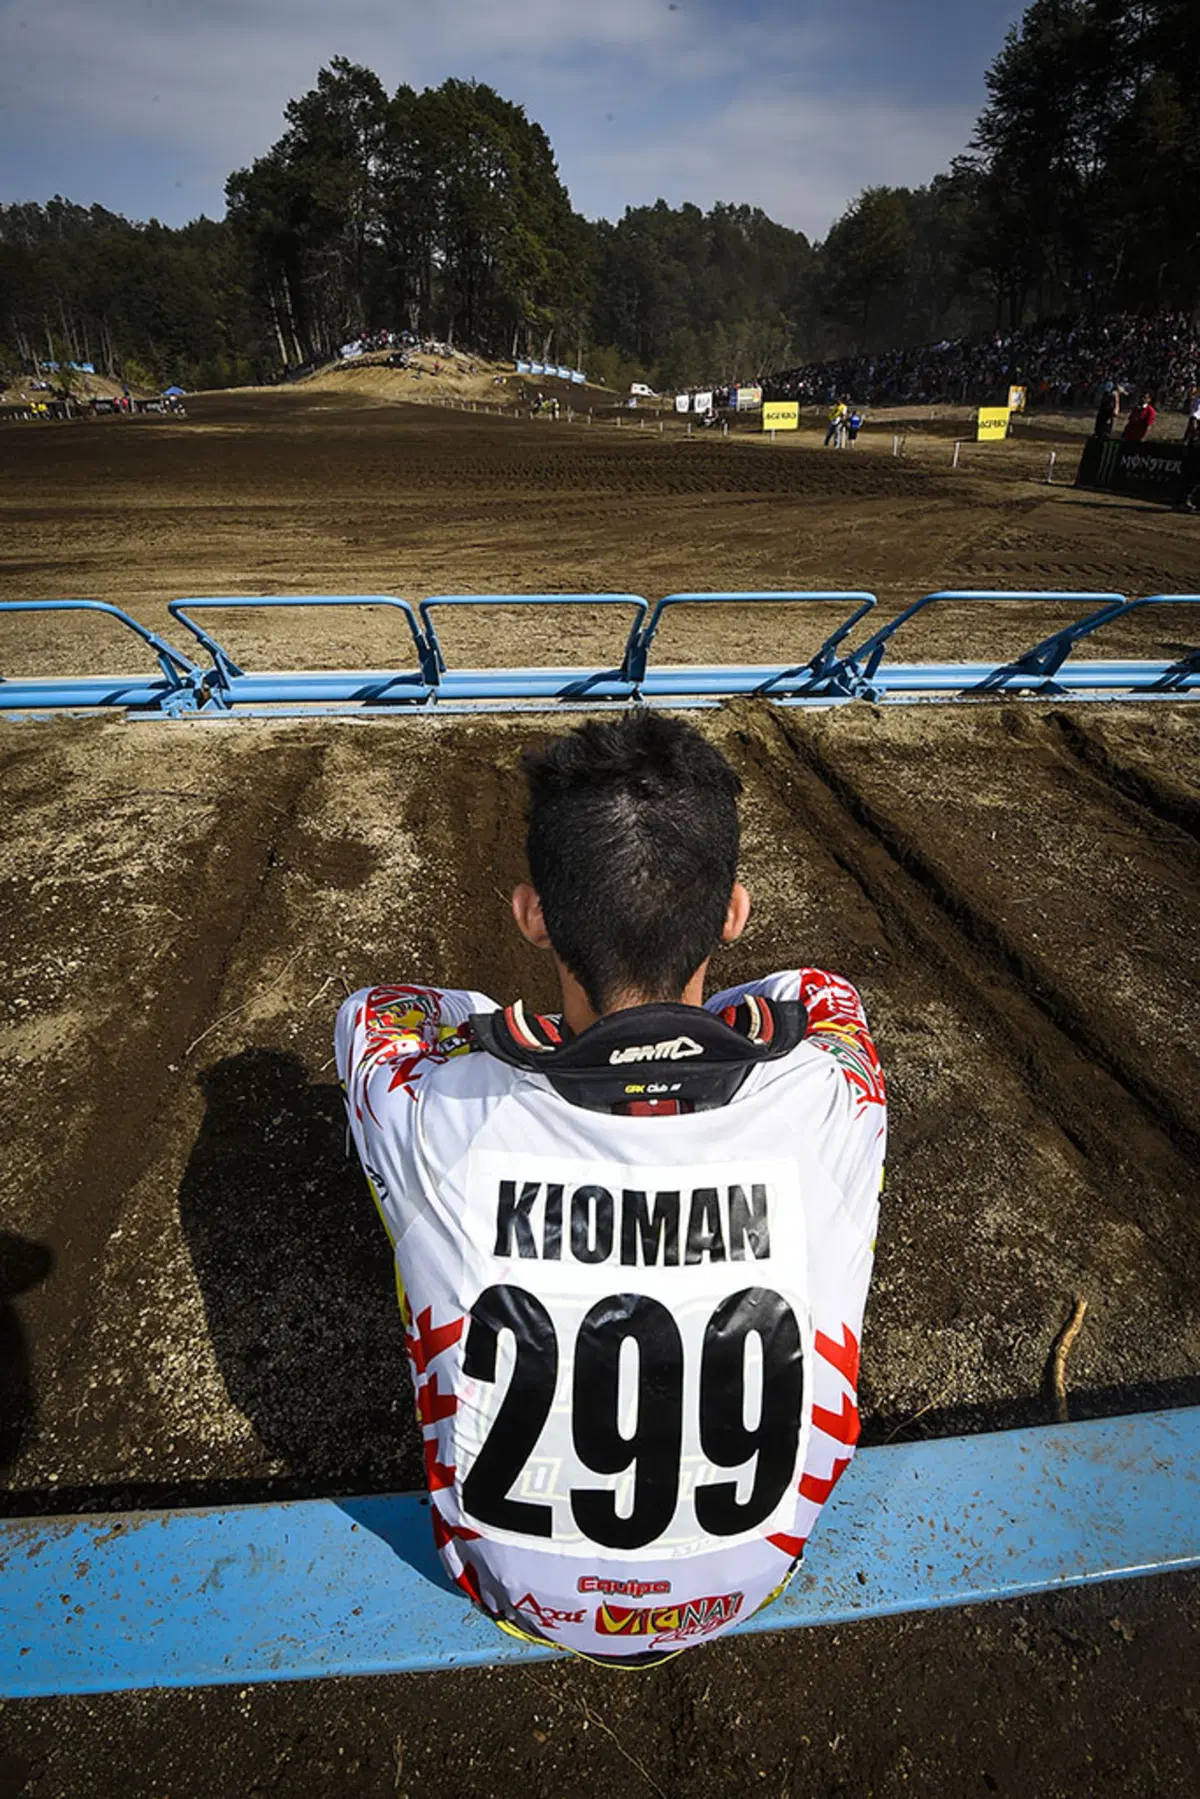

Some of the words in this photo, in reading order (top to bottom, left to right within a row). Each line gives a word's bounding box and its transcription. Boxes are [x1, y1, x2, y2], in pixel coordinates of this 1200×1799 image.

[494, 1180, 771, 1266] KIOMAN
[462, 1284, 804, 1550] 299
[578, 1576, 671, 1598] Equipe
